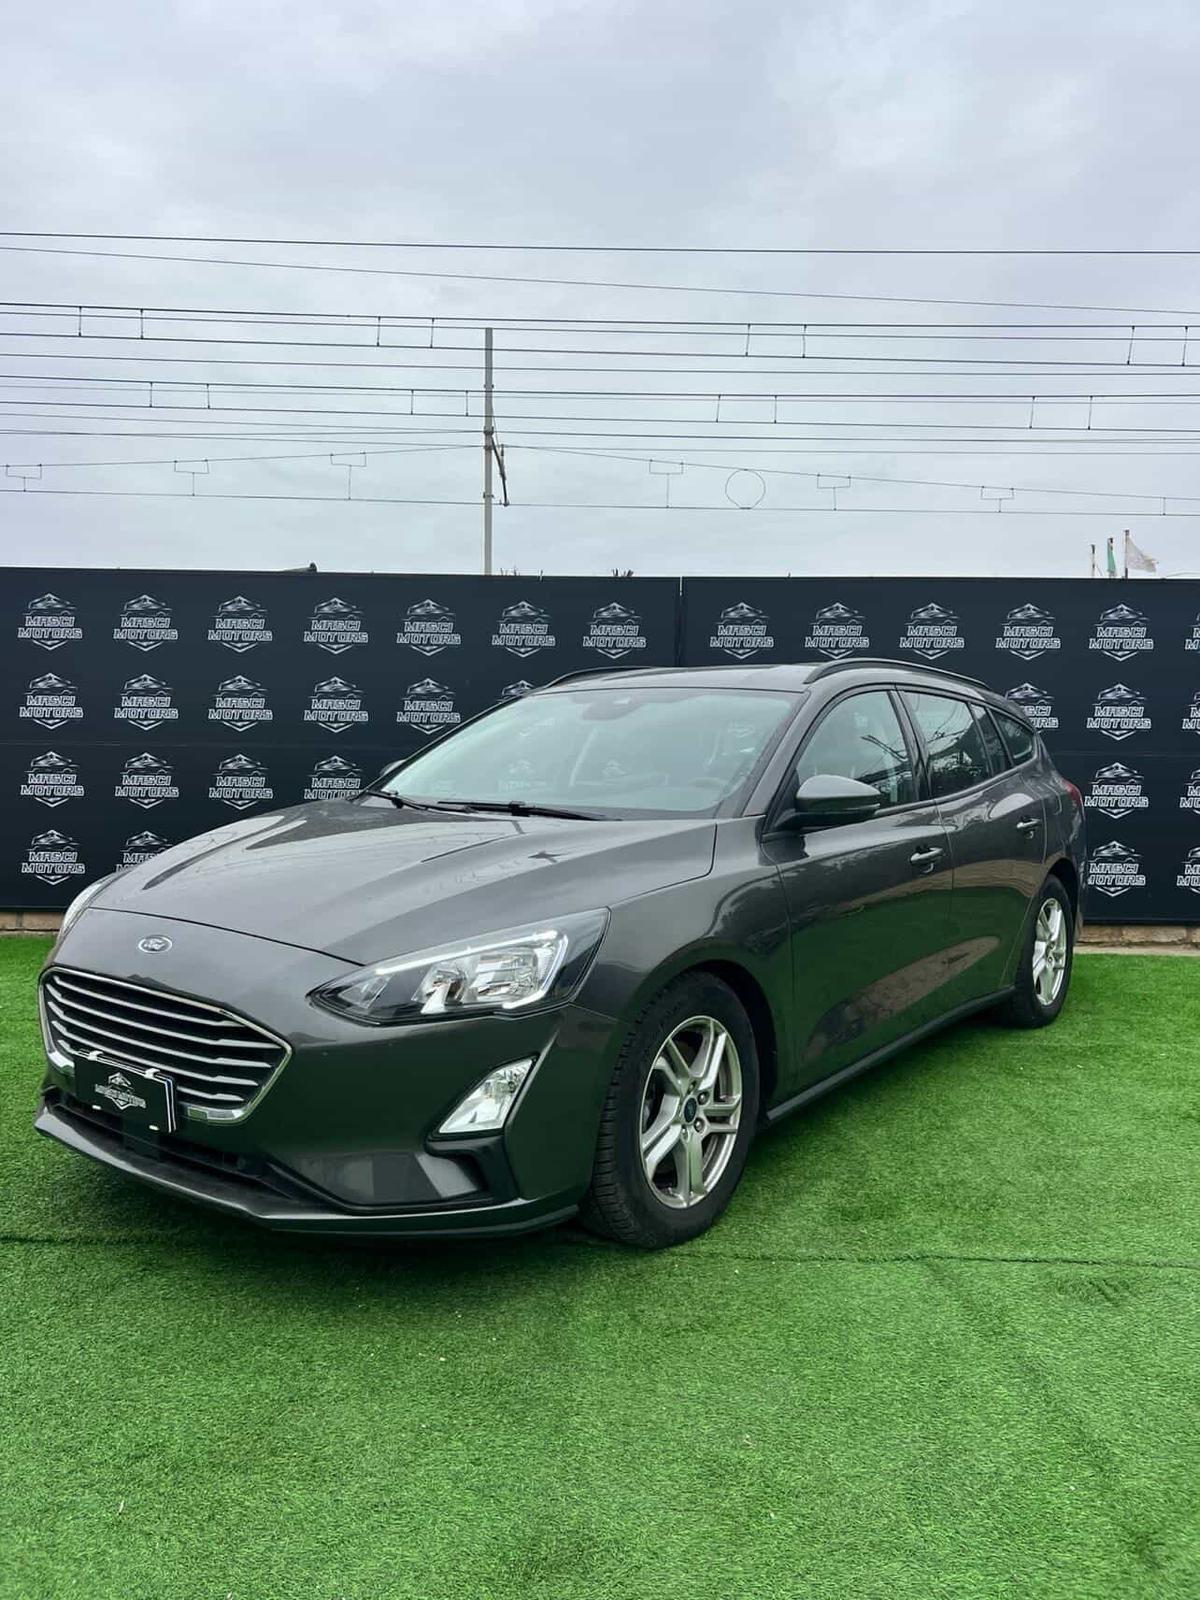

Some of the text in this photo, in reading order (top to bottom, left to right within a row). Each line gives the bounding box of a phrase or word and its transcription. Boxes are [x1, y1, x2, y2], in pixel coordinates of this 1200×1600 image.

[25, 615, 75, 628] MASCI
[120, 616, 171, 629] MASCI
[215, 618, 265, 630] MASCI
[311, 619, 361, 632] MASCI
[404, 621, 454, 633] MASCI
[17, 628, 83, 639] MOTORS
[113, 629, 179, 640] MOTORS
[499, 623, 549, 635] MASCI
[590, 624, 639, 636] MASCI
[717, 624, 767, 636] MASCI
[812, 624, 863, 637] MASCI
[907, 625, 958, 637] MASCI
[1003, 625, 1054, 638] MASCI
[1096, 626, 1147, 638] MASCI
[207, 630, 273, 642] MOTORS
[303, 632, 369, 643] MOTORS
[396, 633, 462, 645] MOTORS
[491, 635, 556, 647] MOTORS
[582, 637, 647, 648] MOTORS
[709, 637, 775, 648] MOTORS
[804, 637, 870, 648] MOTORS
[899, 637, 965, 649] MOTORS
[995, 638, 1061, 649] MOTORS
[1088, 639, 1154, 650] MOTORS
[26, 695, 76, 707] MASCI
[121, 696, 171, 708] MASCI
[215, 697, 266, 709] MASCI
[311, 698, 361, 711] MASCI
[403, 700, 454, 712] MASCI
[19, 707, 84, 719] MOTORS
[113, 708, 179, 719] MOTORS
[208, 709, 273, 721] MOTORS
[303, 711, 369, 722] MOTORS
[1023, 705, 1052, 717] SCI
[1094, 705, 1145, 718] MASCI
[396, 712, 461, 724] MOTORS
[1086, 718, 1152, 729] MOTORS
[27, 773, 77, 785] MASCI
[121, 774, 172, 786] MASCI
[215, 776, 266, 788] MASCI
[311, 777, 361, 789] MASCI
[20, 785, 85, 797] MOTORS
[114, 787, 180, 798] MOTORS
[208, 788, 274, 799] MOTORS
[303, 789, 359, 800] MOTOR
[1091, 784, 1142, 796] MASCI
[1084, 796, 1149, 808] MOTORS
[28, 851, 78, 863] MASCI
[21, 863, 86, 874] MOTORS
[1089, 862, 1139, 875] MASCI
